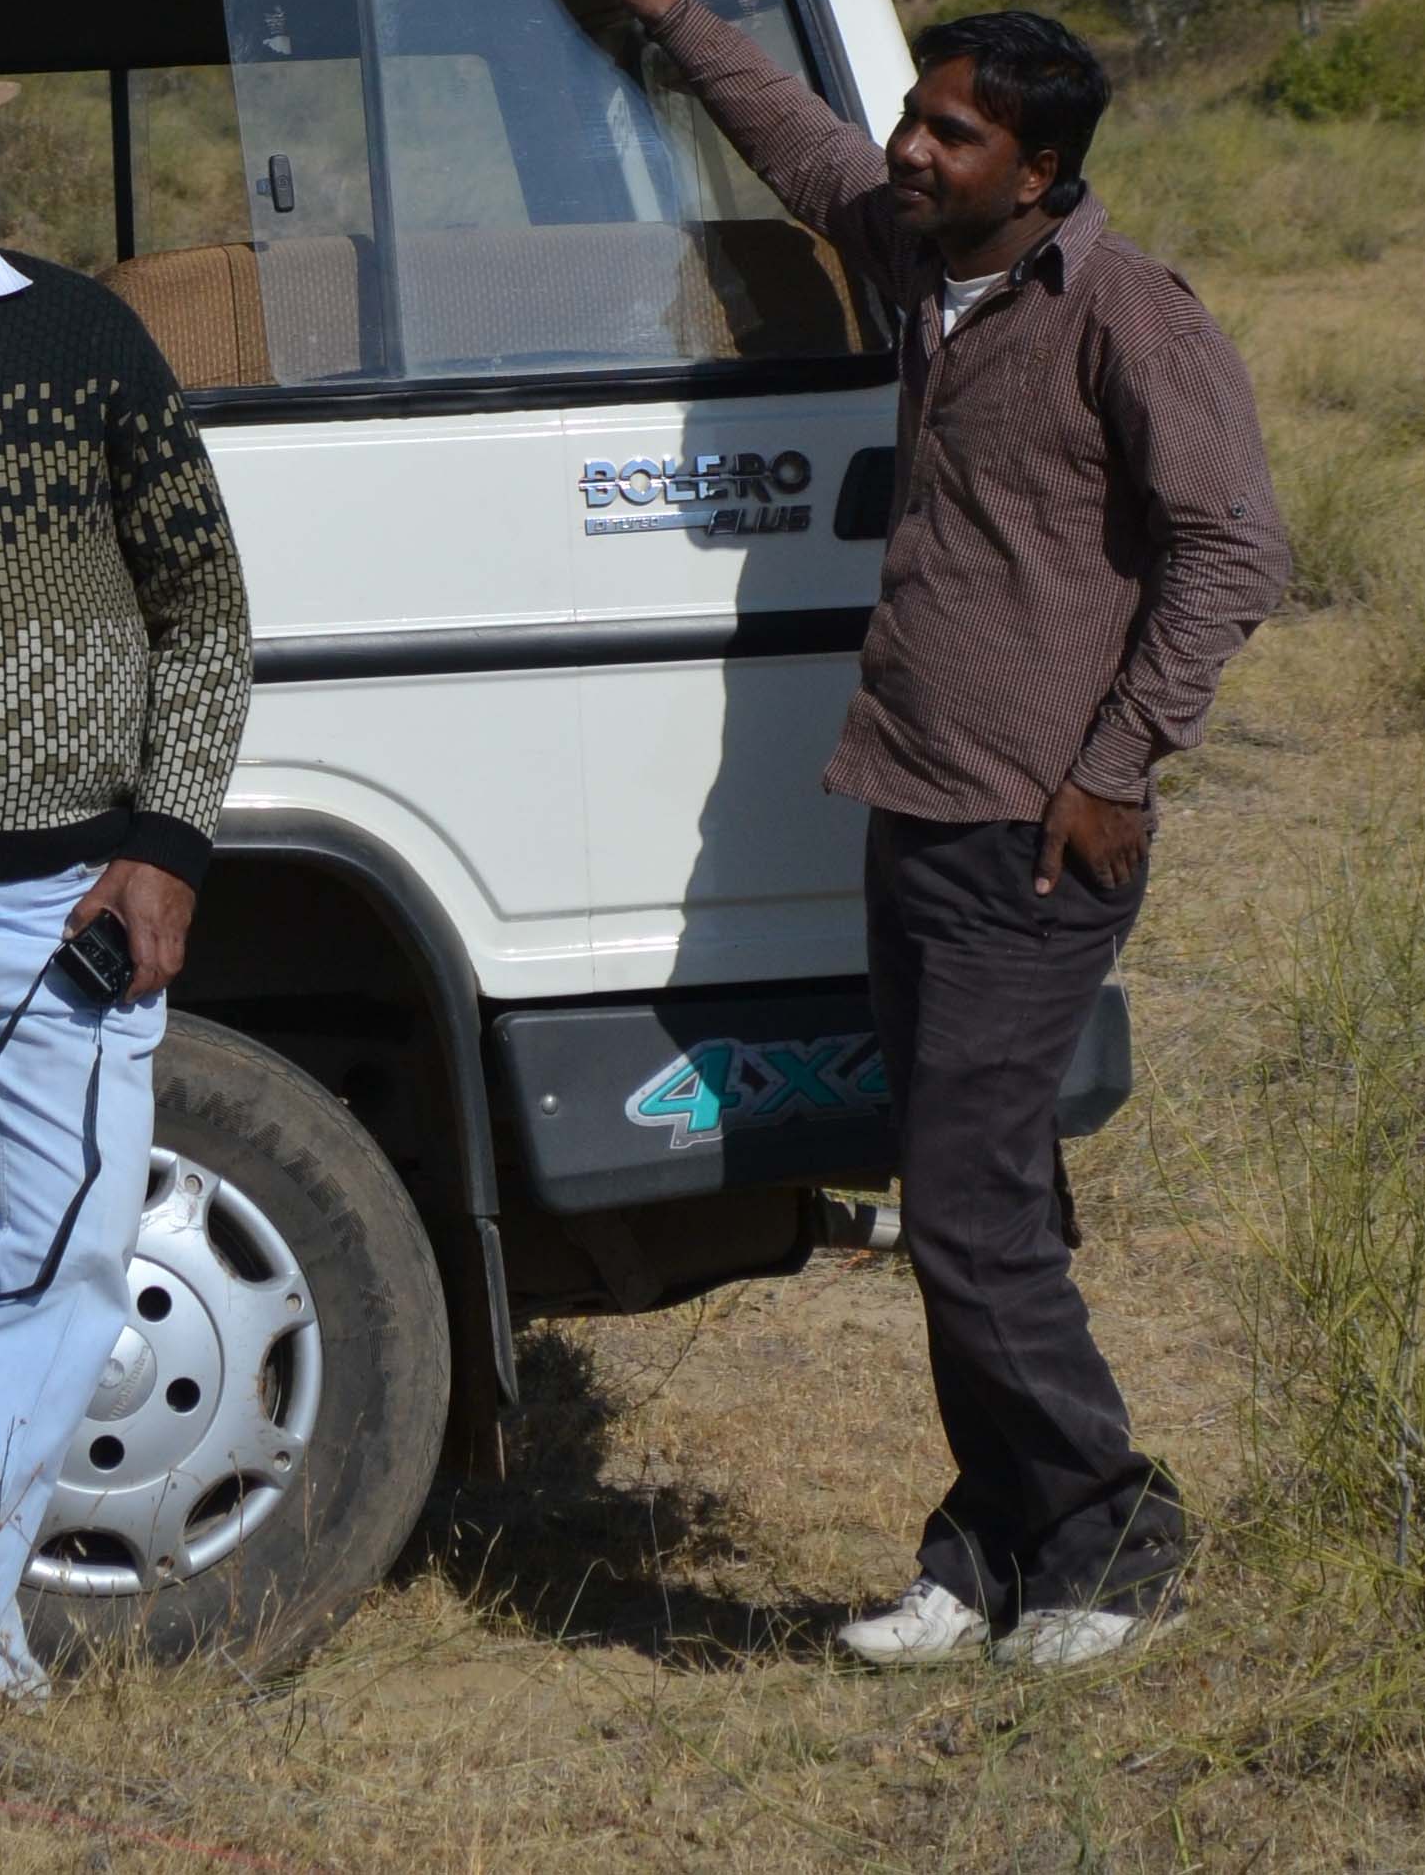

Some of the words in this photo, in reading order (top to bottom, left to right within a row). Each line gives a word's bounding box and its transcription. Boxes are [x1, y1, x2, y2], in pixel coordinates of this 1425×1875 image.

[583, 450, 812, 508] BOLERO
[705, 505, 812, 536] PLUS
[627, 1039, 891, 1139] 4X
